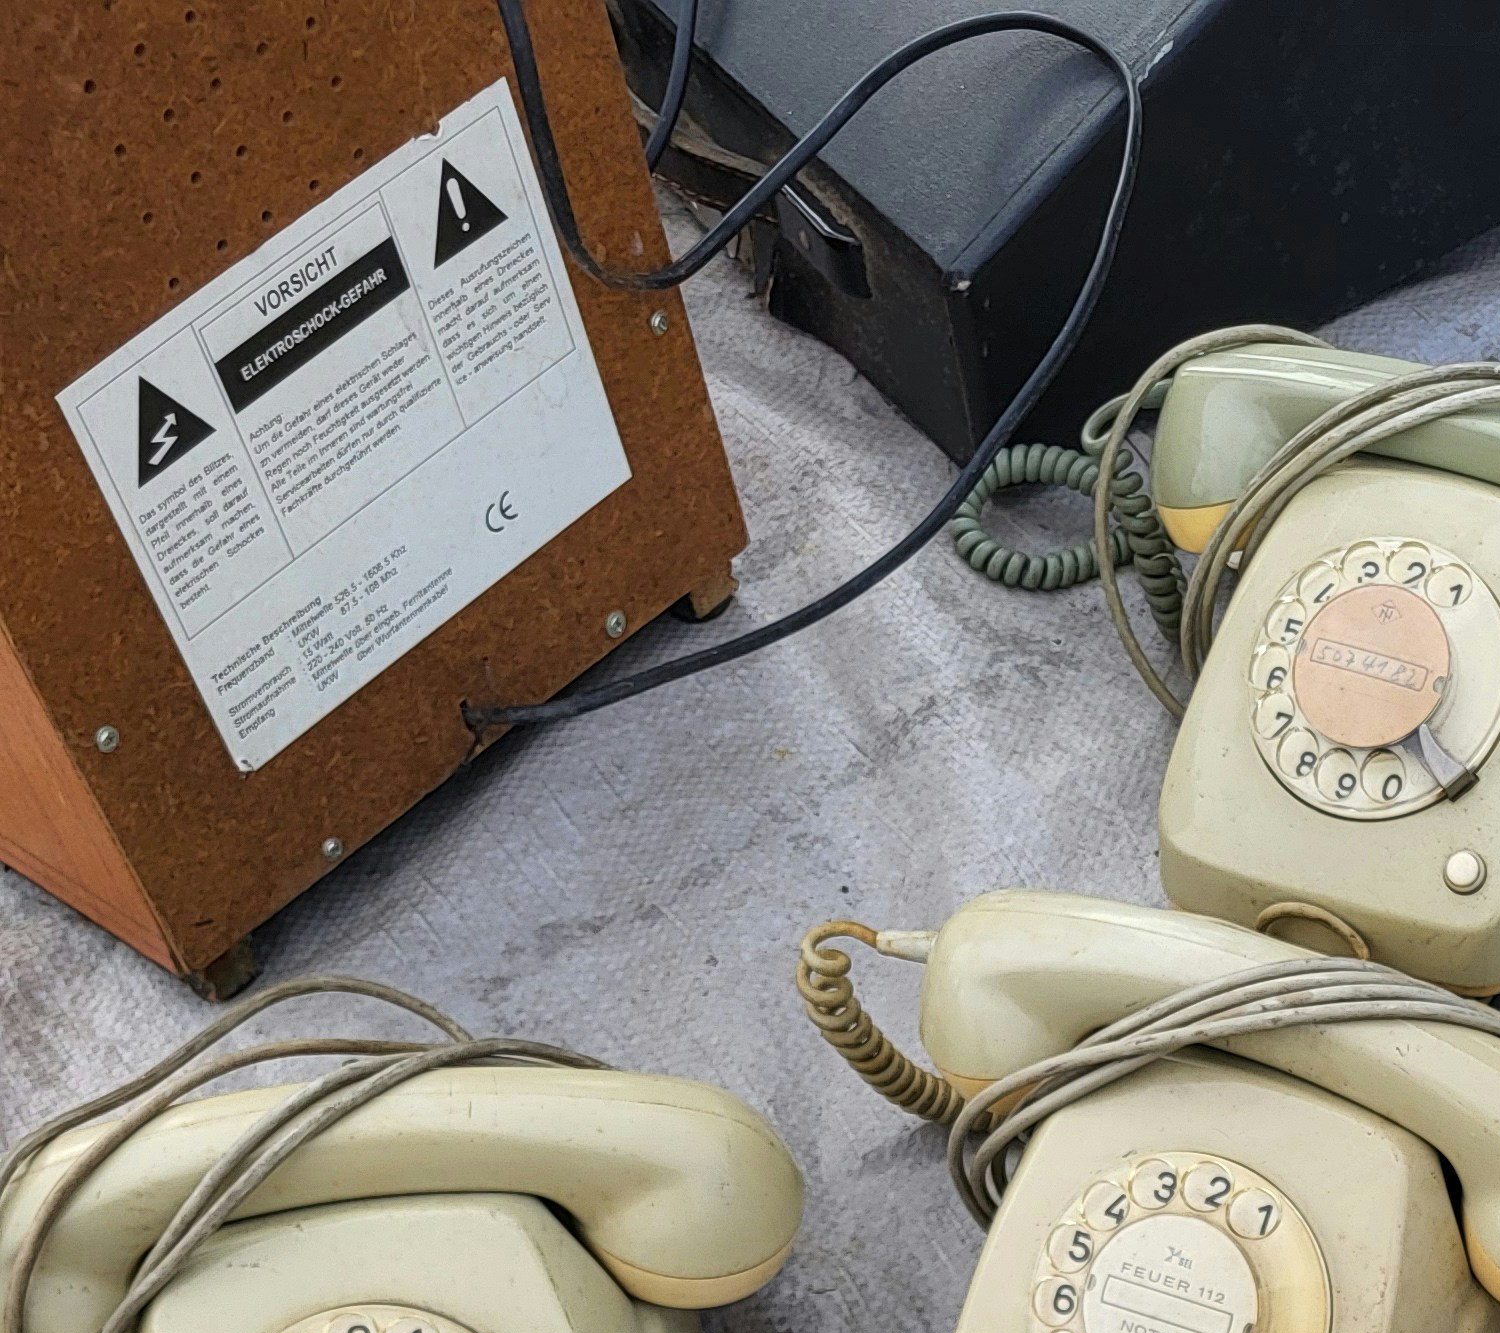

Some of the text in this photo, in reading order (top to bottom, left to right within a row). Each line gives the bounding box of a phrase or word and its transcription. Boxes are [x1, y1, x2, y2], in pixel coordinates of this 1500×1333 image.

[253, 245, 337, 317] VORSICHT
[473, 275, 494, 294] eines
[427, 287, 455, 311] Dieses
[240, 268, 387, 381] ELEKTROSCHOCK-GEFAHR
[442, 331, 461, 349] dass
[466, 320, 476, 330] es
[481, 304, 498, 320] sich
[502, 291, 516, 304] um
[451, 360, 463, 374] der
[253, 440, 270, 455] Um
[271, 430, 283, 443] die
[313, 392, 334, 412] eines
[264, 457, 292, 481] Regen
[291, 441, 313, 460] noch
[271, 477, 287, 493] Alle
[307, 453, 319, 465] im
[138, 508, 157, 525] Das
[188, 473, 203, 488] des
[221, 477, 243, 497] eines
[169, 568, 189, 586] dass
[192, 556, 204, 568] die
[239, 513, 260, 533] eines
[1402, 561, 1426, 584] 2
[1450, 584, 1464, 606] 1
[1280, 619, 1303, 641] 5
[1267, 666, 1288, 688] 6
[1272, 711, 1292, 737] 7
[1296, 751, 1317, 777] 8
[1335, 773, 1356, 799] 9
[1381, 774, 1402, 800] 0
[1153, 1171, 1177, 1204] 3
[1205, 1176, 1231, 1208] 2
[1105, 1194, 1127, 1224] 4
[1257, 1204, 1273, 1236] 1
[1068, 1230, 1091, 1262] 5
[1119, 1262, 1225, 1305] FEUER 112
[1053, 1284, 1077, 1314] 6
